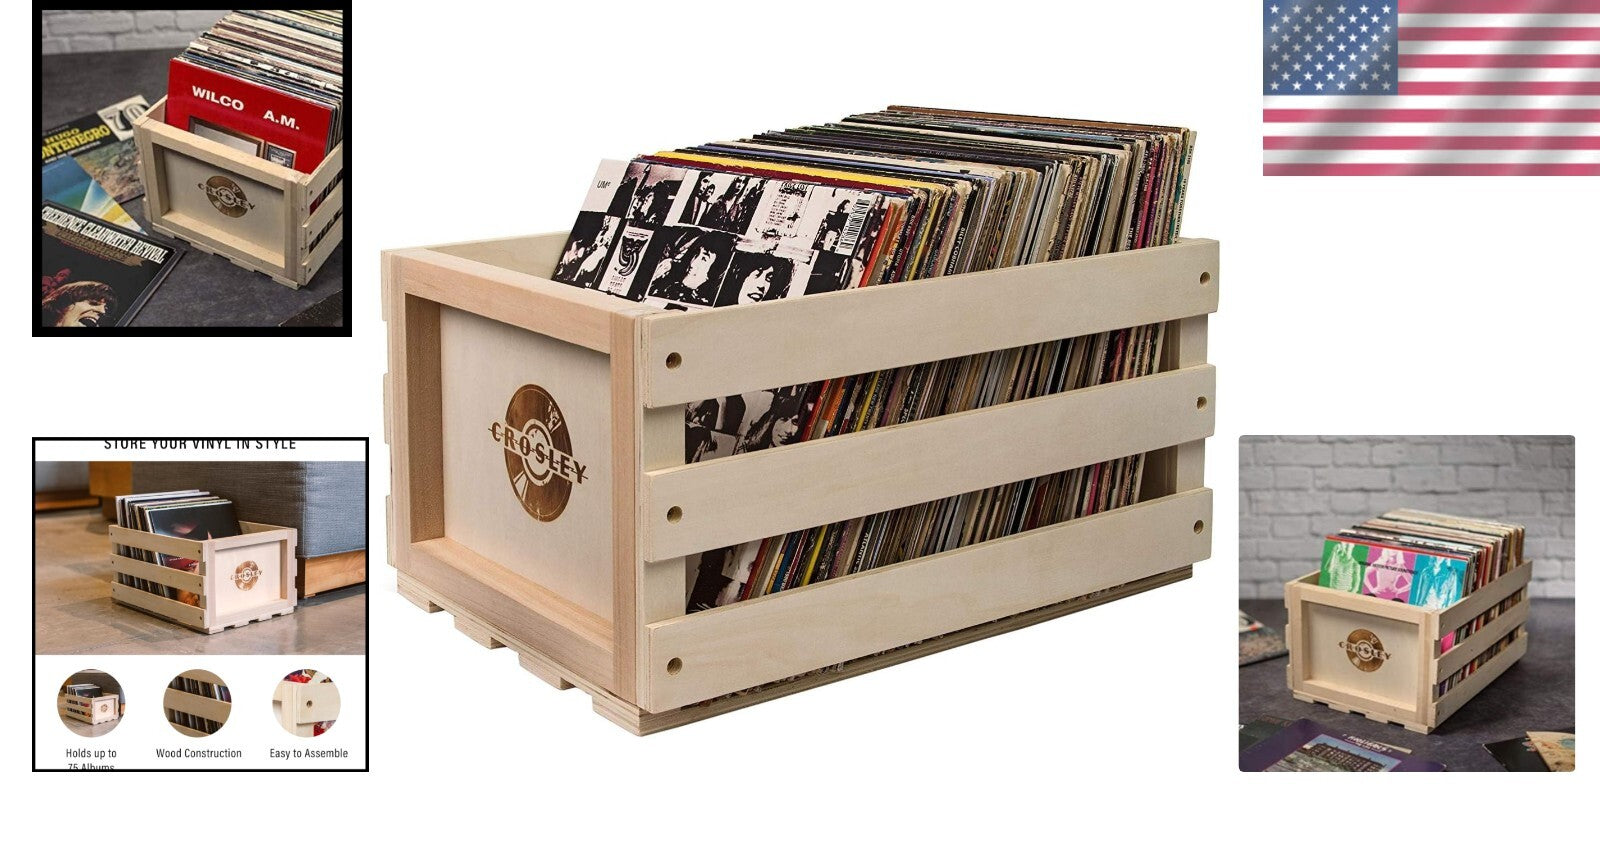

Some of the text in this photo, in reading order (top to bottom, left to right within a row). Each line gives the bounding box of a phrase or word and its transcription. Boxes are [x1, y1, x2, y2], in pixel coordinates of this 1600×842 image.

[192, 85, 300, 130] WILCO A.M.
[44, 127, 80, 144] HUGO
[197, 183, 256, 210] CROSLEY
[80, 221, 137, 251] CLEARWATER
[130, 240, 169, 265] REVIVAL
[955, 226, 966, 245] BILLY
[104, 440, 296, 450] STORE YOUR VINYL IN STYLE
[488, 421, 589, 484] CROSLEY
[854, 531, 870, 565] ATLANTIC
[1338, 641, 1392, 660] CROSLEY
[67, 749, 116, 759] Holds up to
[156, 749, 241, 757] Wood Construction
[270, 749, 348, 760] Easy to Assemble
